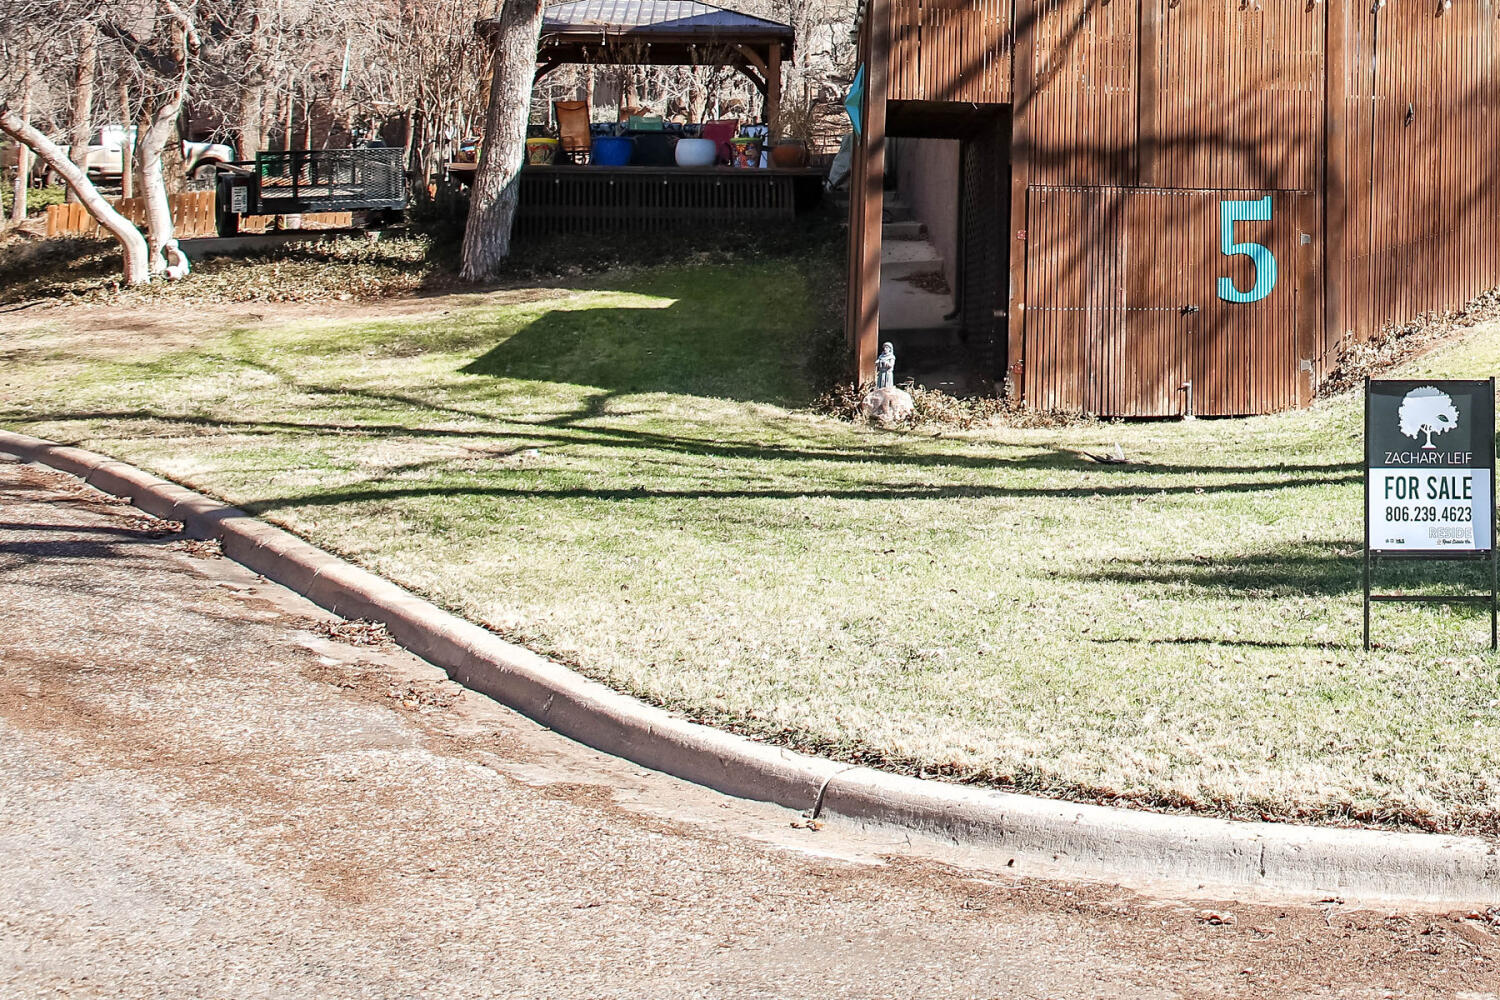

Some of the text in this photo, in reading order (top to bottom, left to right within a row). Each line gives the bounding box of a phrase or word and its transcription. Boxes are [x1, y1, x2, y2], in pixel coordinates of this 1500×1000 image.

[1217, 195, 1278, 304] 5
[1384, 451, 1473, 464] ZACHARY LEIF
[1384, 476, 1473, 500] FOR SALE
[1385, 506, 1472, 522] 806.239.4623
[1428, 527, 1473, 538] RESIDE
